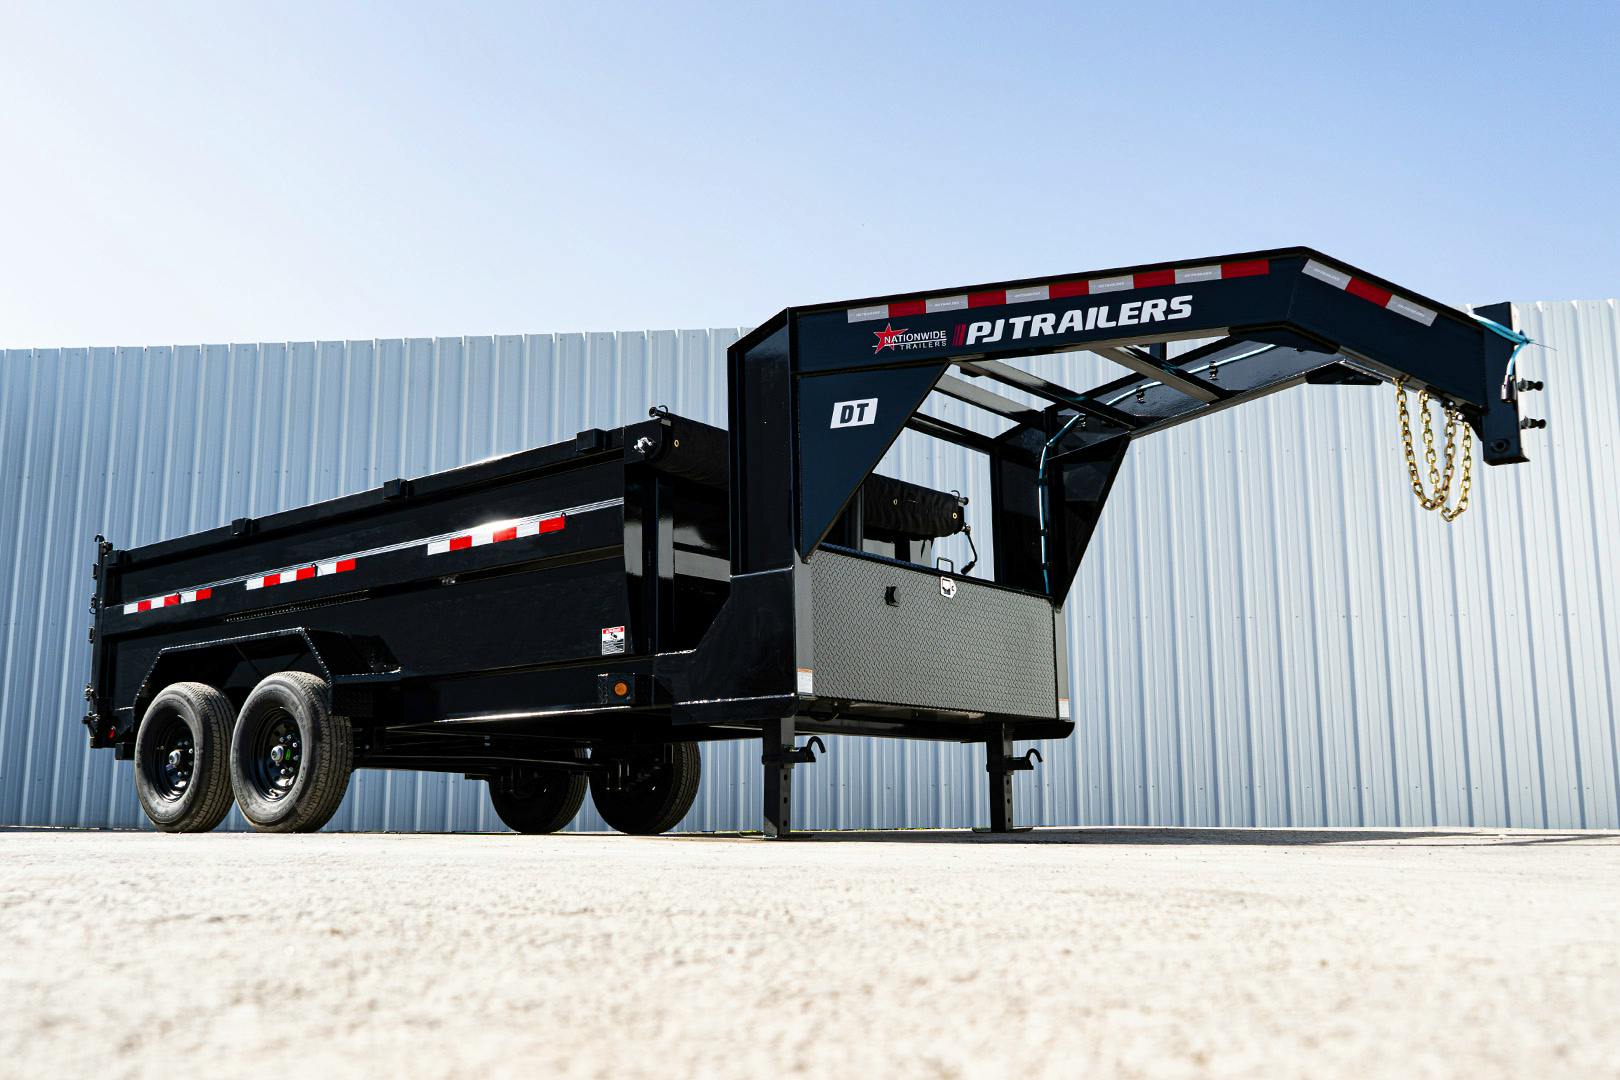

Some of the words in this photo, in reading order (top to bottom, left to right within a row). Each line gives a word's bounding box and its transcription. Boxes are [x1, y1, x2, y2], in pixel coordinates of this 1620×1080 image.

[884, 330, 947, 344] NATIONWIDE
[900, 341, 947, 351] TRAILERS
[840, 403, 869, 424] DT
